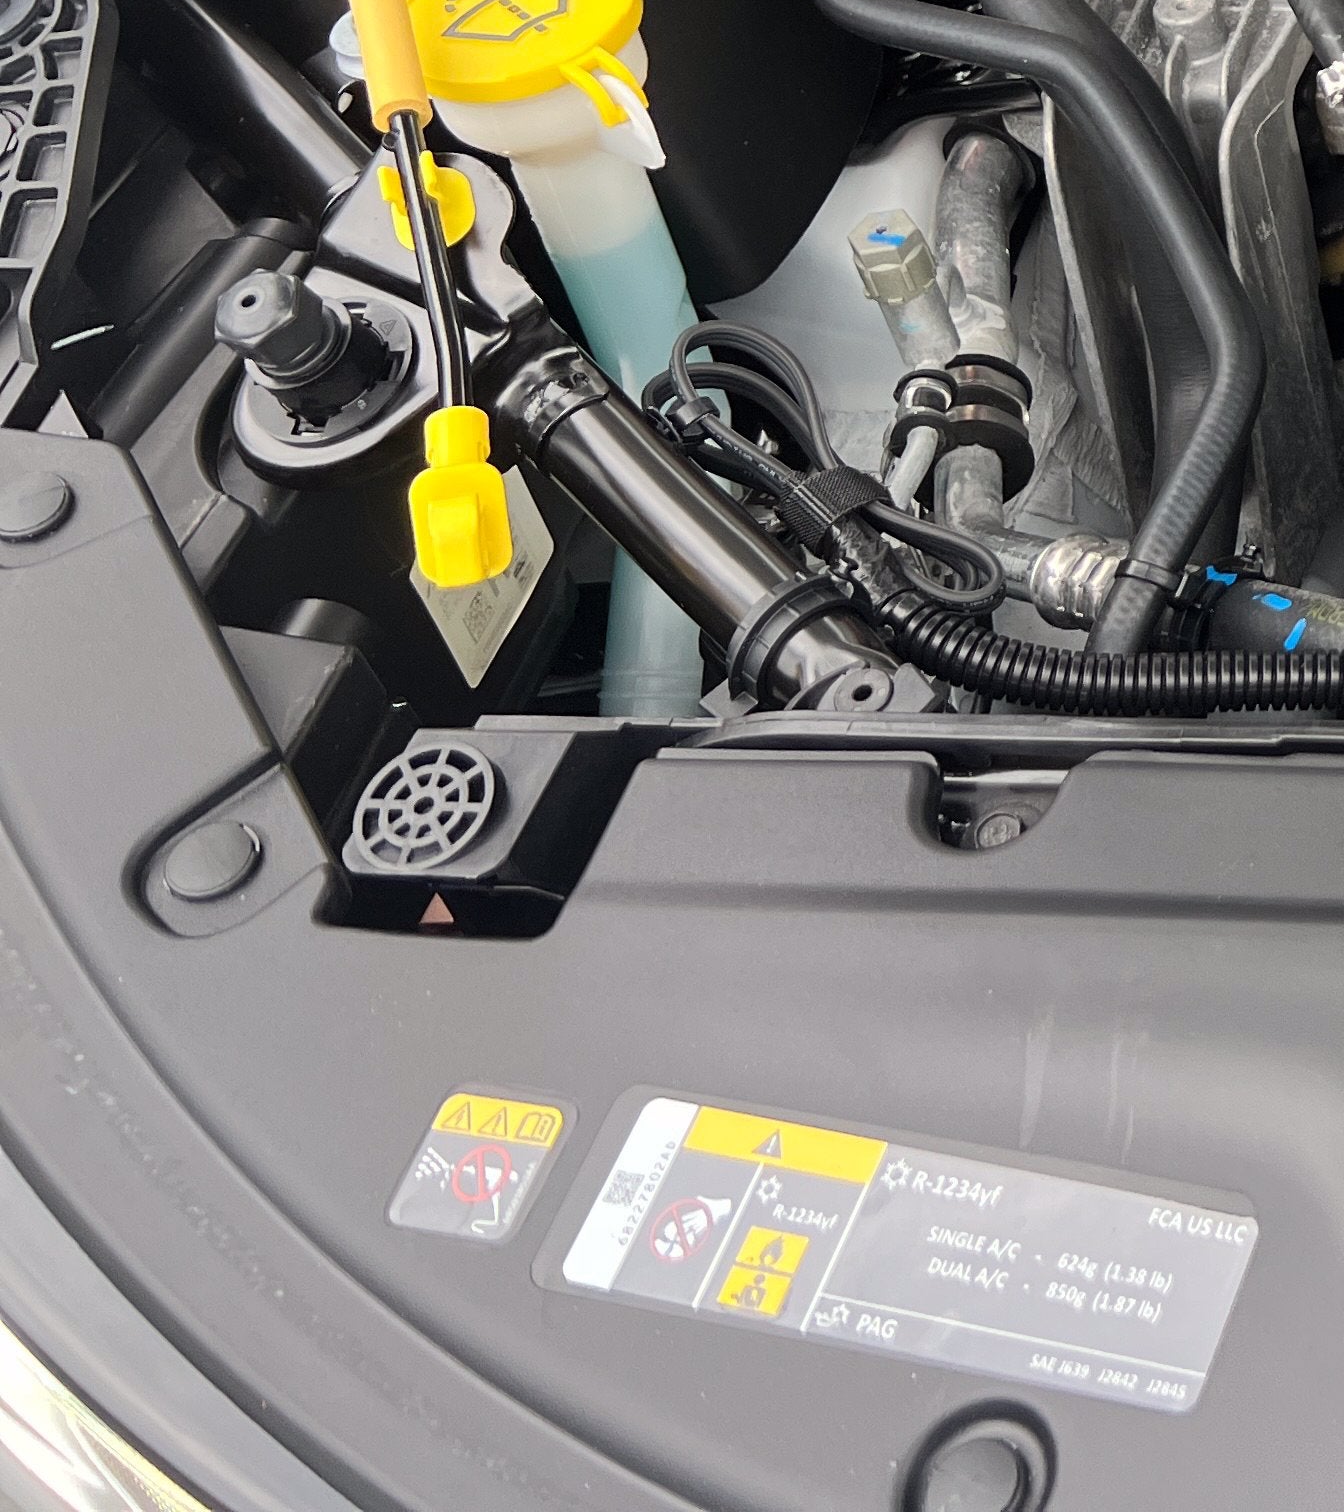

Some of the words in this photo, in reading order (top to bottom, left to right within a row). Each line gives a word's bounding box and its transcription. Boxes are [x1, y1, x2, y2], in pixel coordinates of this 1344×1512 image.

[911, 1170, 1004, 1209] R-1234yf
[772, 1204, 840, 1230] R-1234yf
[1147, 1207, 1183, 1233] FCA
[1187, 1210, 1214, 1237] US
[1215, 1215, 1249, 1243] LLC
[926, 1225, 985, 1253] SINGLE
[985, 1238, 1022, 1262] A/C
[1057, 1252, 1097, 1280] 624g
[1103, 1259, 1148, 1286] (1.38
[1148, 1270, 1174, 1294] lb)
[927, 1256, 972, 1284] DUAL
[973, 1268, 1010, 1291] A/C
[1045, 1282, 1087, 1308] 850g
[1092, 1289, 1136, 1316] (1.87
[1136, 1300, 1162, 1325] lb)
[855, 1313, 899, 1340] PAG
[1029, 1352, 1058, 1371] SAE
